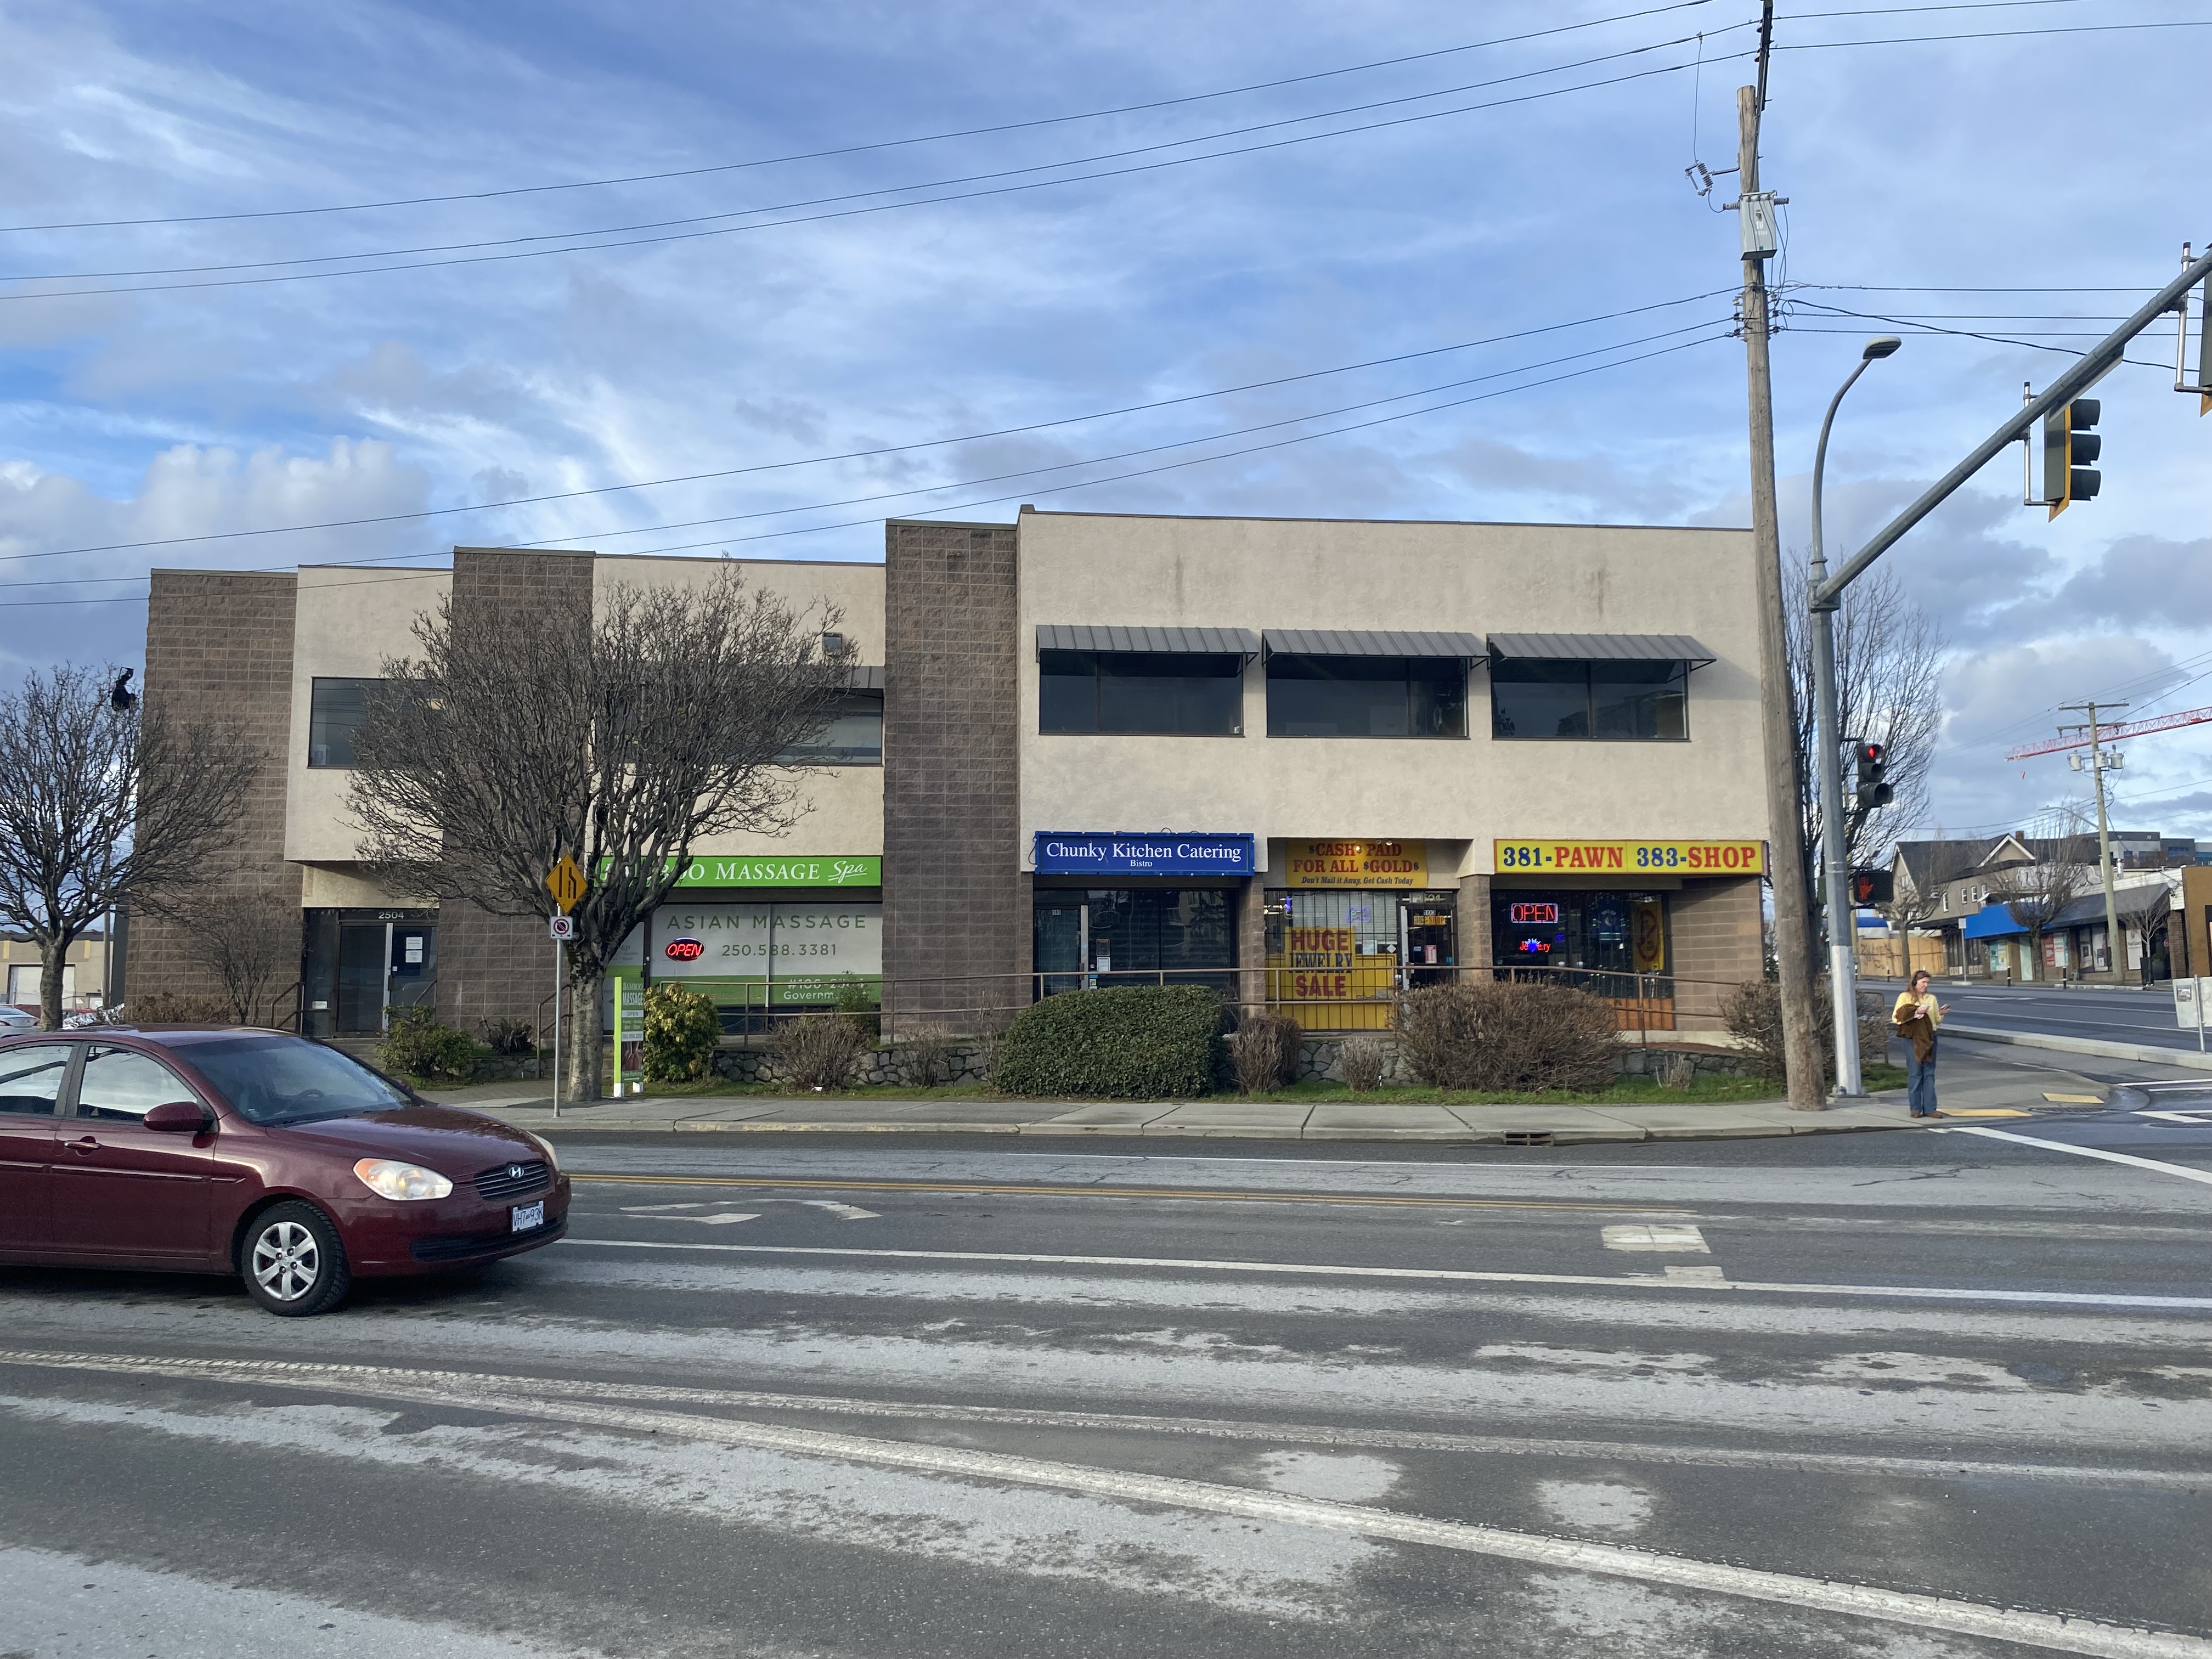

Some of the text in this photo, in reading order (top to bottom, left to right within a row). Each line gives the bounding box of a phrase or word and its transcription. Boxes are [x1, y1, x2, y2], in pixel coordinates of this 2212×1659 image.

[1046, 842, 1242, 862] Chunky Kitchen Catering
[1366, 843, 1402, 856] PAID
[1503, 847, 1756, 868] 381-PAWN 383-SHOP
[714, 862, 820, 880] MASSAGE
[828, 860, 867, 884] Spa
[1293, 860, 1419, 873] FOR ALL $GOLD$
[1344, 877, 1361, 886] Away,
[1394, 877, 1414, 886] Today
[1512, 904, 1558, 922] OPEN
[667, 915, 866, 929] ASIAN MASSAGE
[1291, 929, 1349, 951] HUGE
[668, 944, 702, 957] OPEN
[721, 944, 836, 956] 250.588.3381
[1288, 952, 1353, 973] JEWELRY
[623, 982, 643, 991] BAMBOO
[1296, 975, 1347, 997] SALE
[622, 992, 643, 1006] MASSAGE
